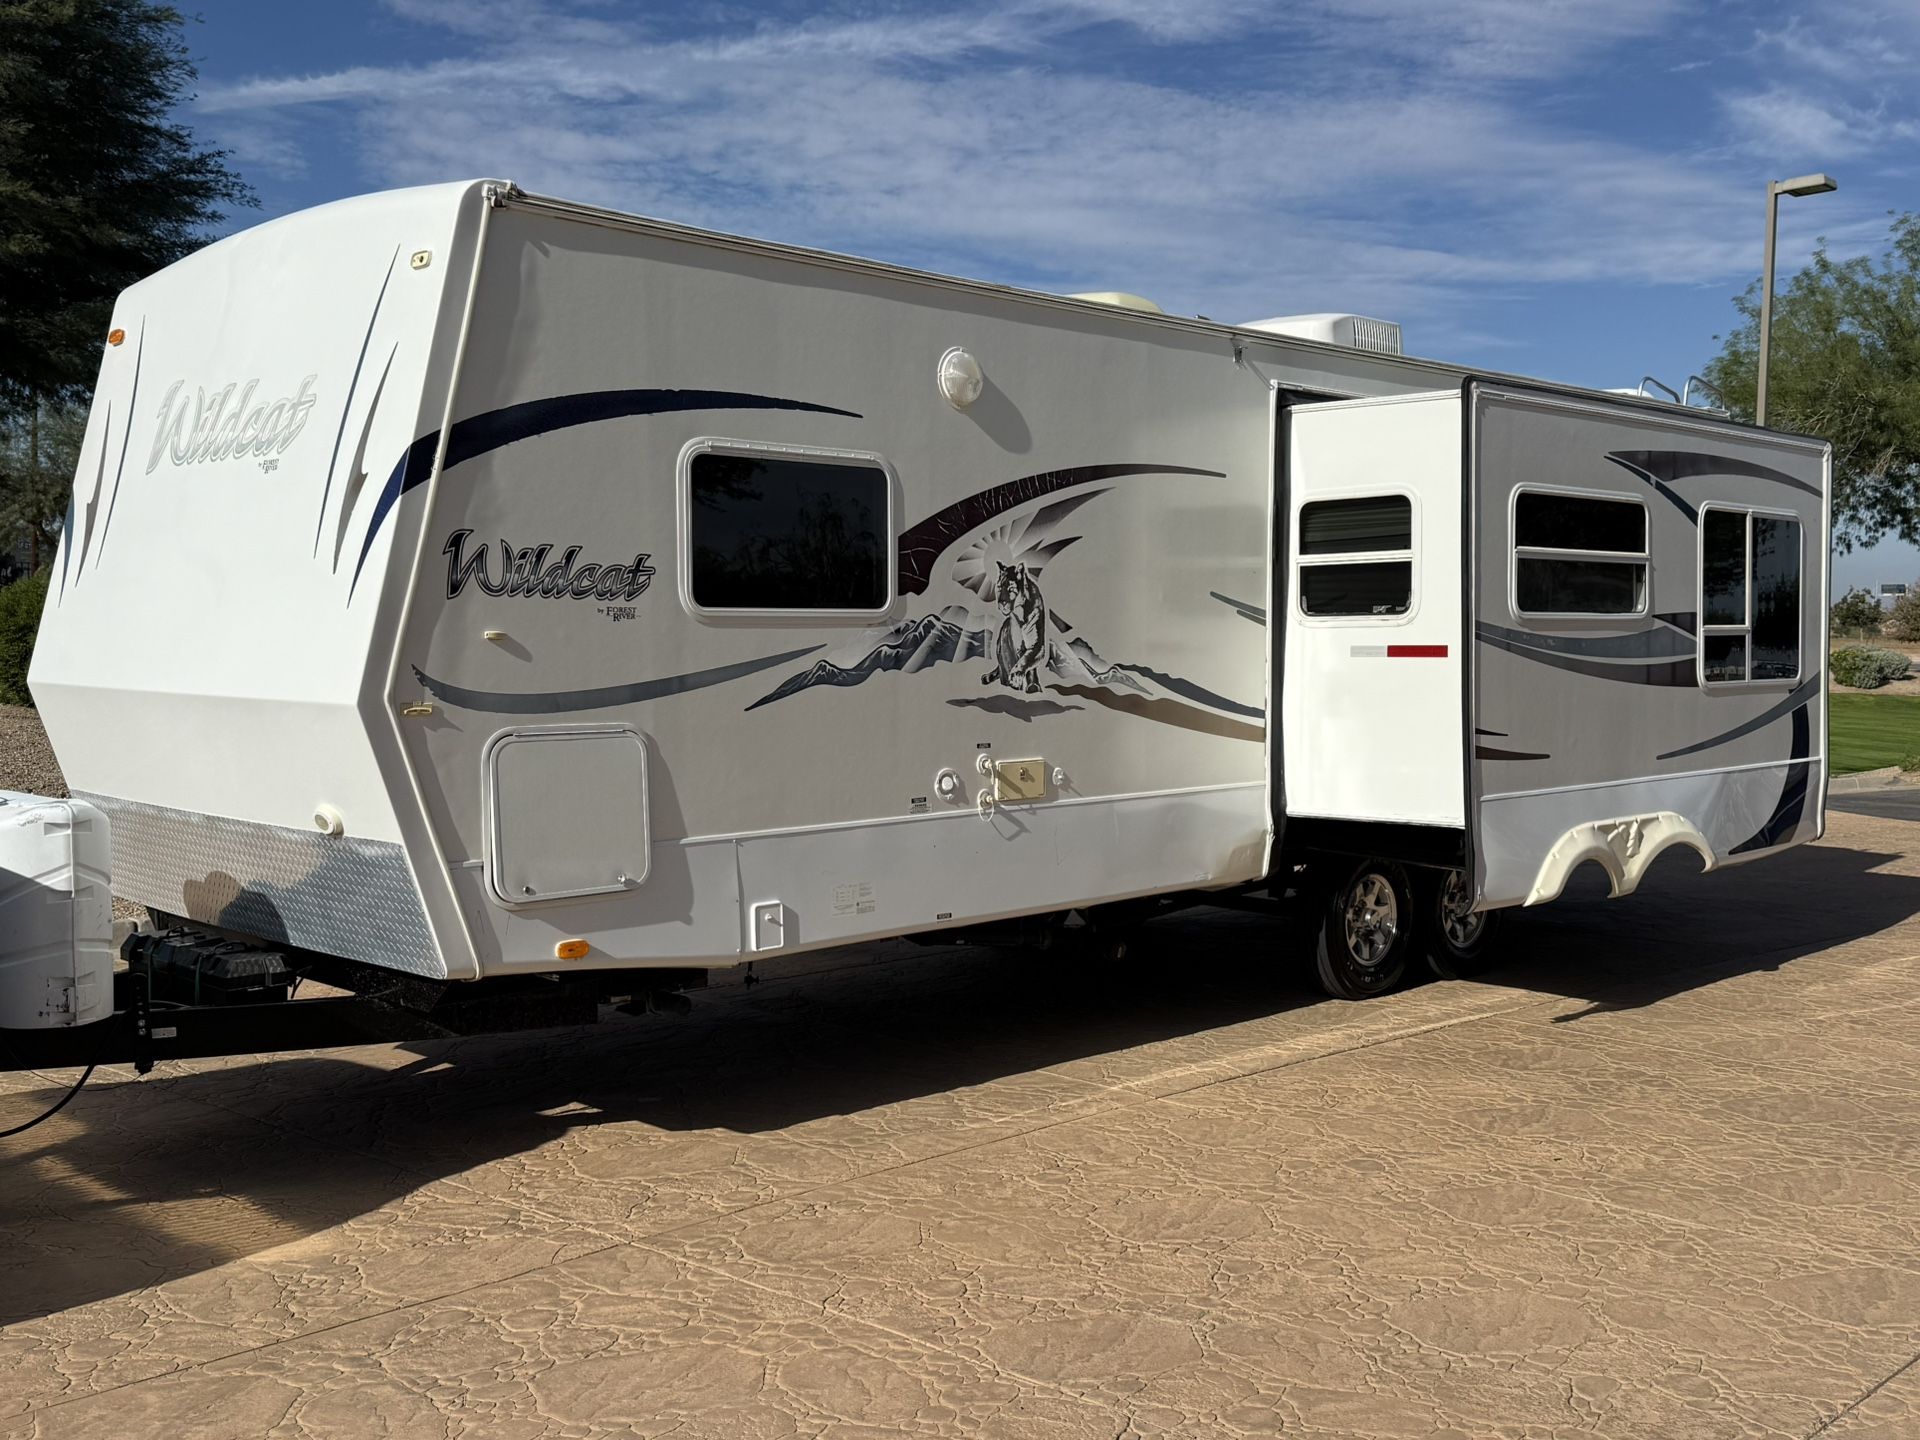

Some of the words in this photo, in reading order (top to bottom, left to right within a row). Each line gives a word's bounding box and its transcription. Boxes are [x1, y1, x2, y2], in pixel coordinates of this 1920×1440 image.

[145, 374, 318, 476] Wildcat
[443, 529, 656, 601] Wildcat
[606, 606, 638, 616] FOREST
[613, 612, 636, 622] RIVER
